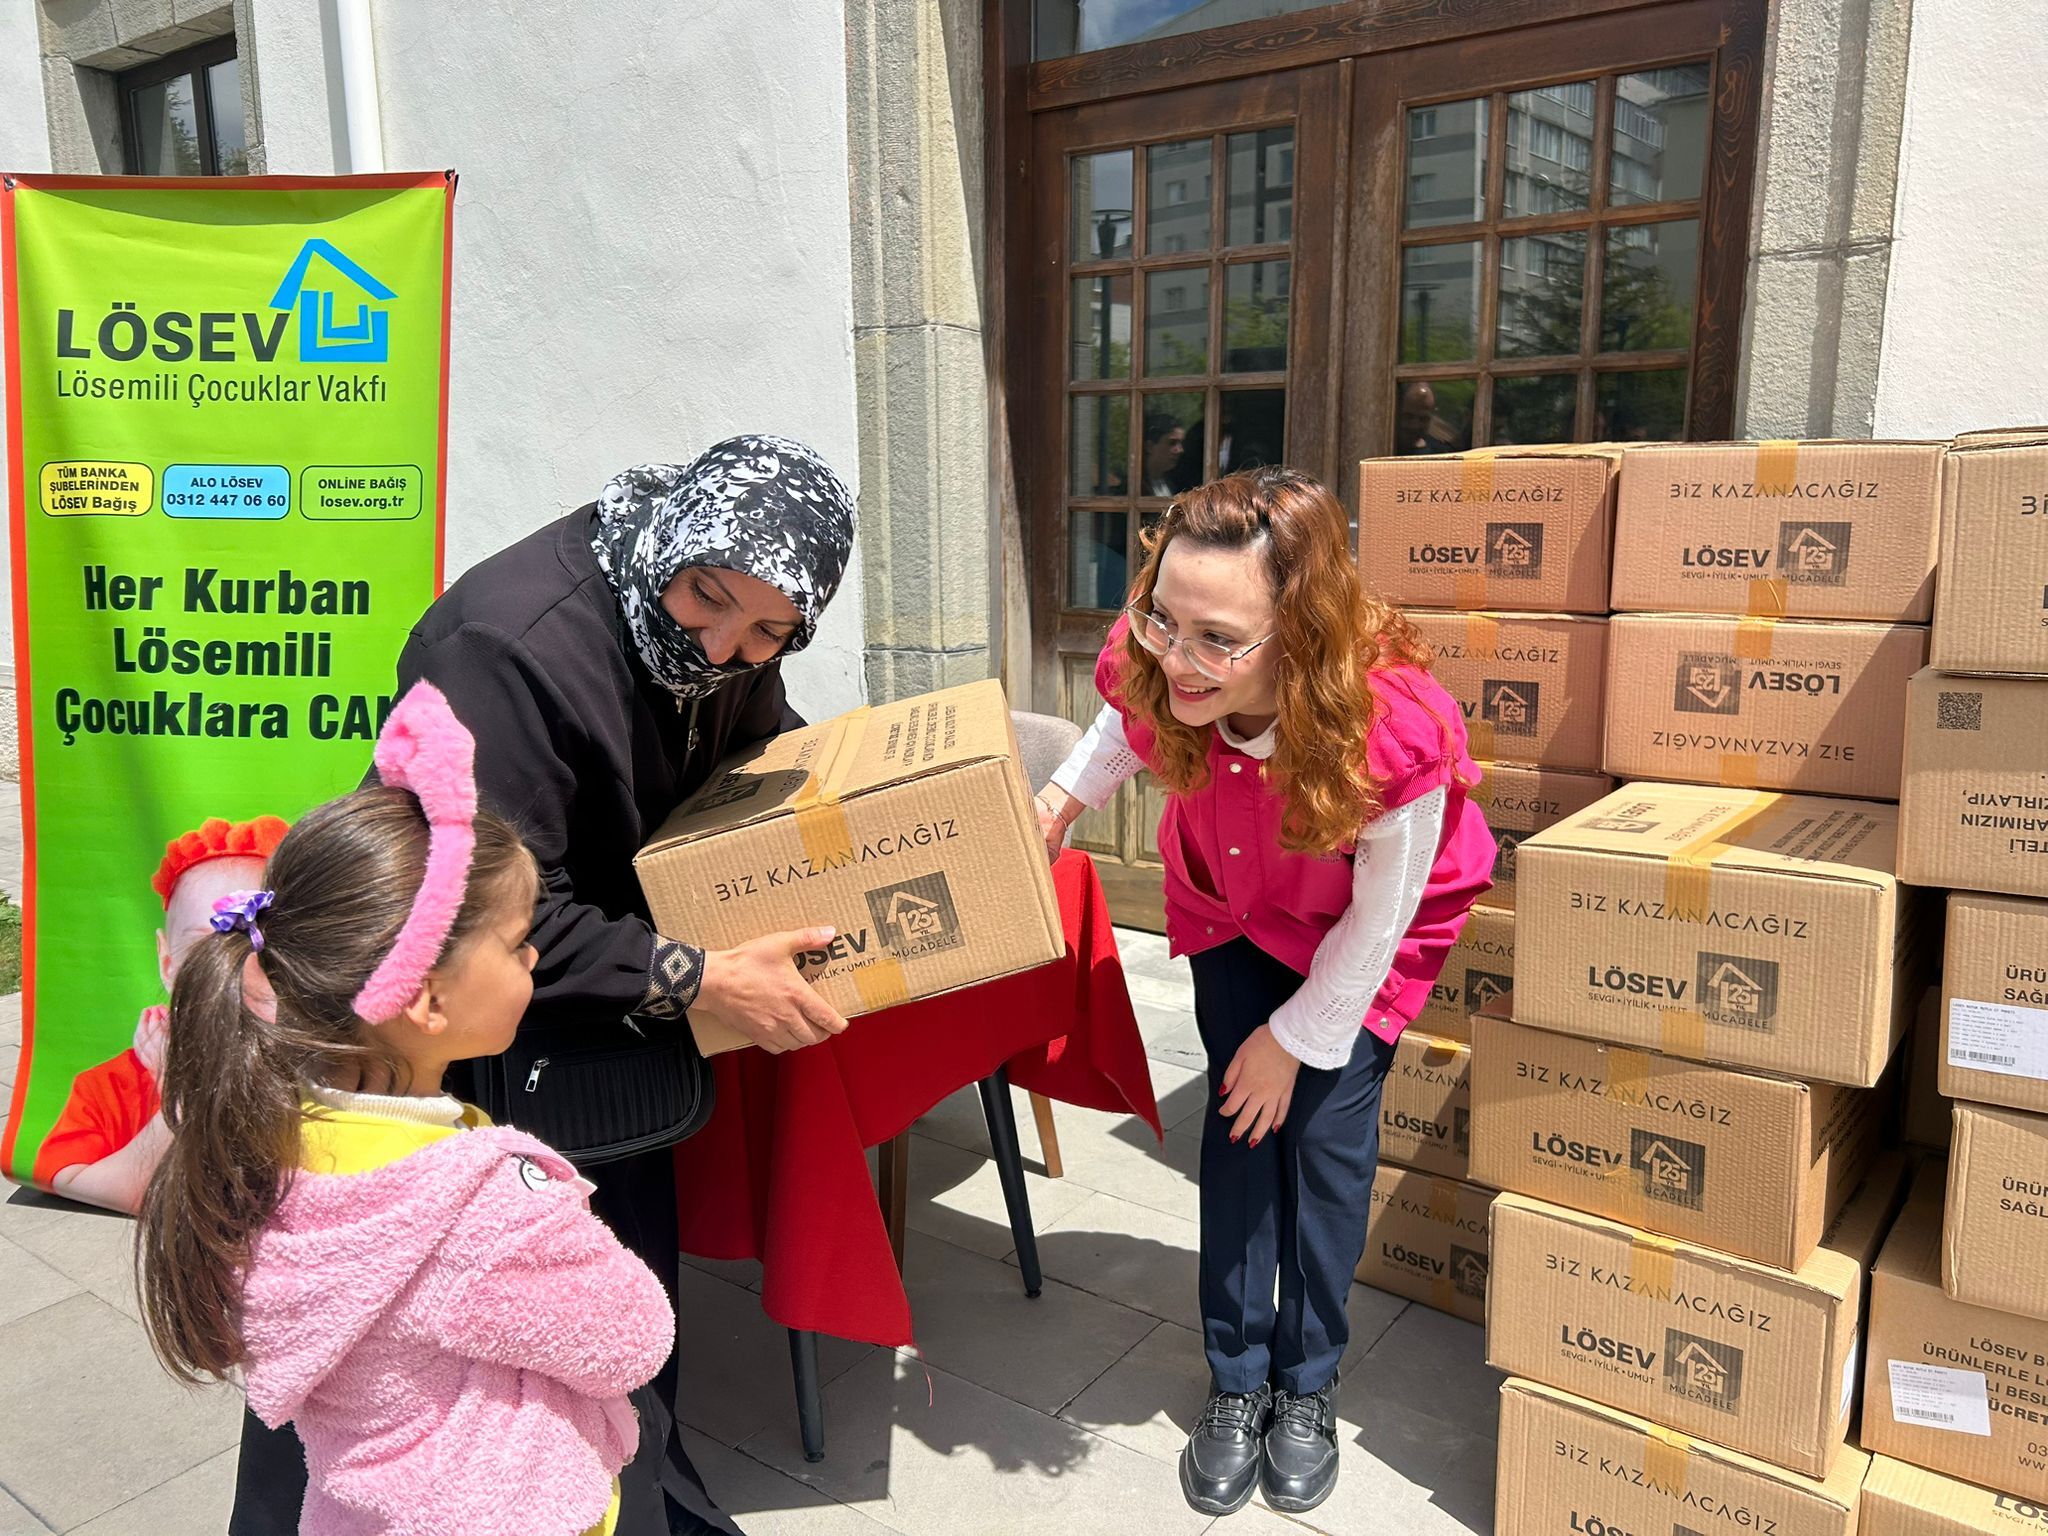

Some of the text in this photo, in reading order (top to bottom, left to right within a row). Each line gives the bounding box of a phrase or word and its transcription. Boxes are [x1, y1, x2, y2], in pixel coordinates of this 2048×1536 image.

[57, 302, 290, 362] LÖSEV
[57, 370, 387, 408] Lösemili Çocuklar Vakfı
[57, 466, 128, 479] TÜM BANKA
[190, 475, 263, 489] ALO LÖSEV
[318, 477, 407, 491] ONLİNE BAĞIŞ
[49, 476, 140, 493] ŞUBELERİNDEN
[1712, 480, 1879, 498] KAZANACAĞIZ
[52, 495, 137, 512] LÖSEV Bağış
[166, 493, 287, 508] 0312 447 06 60
[320, 495, 405, 510] losev.org.tr
[2021, 494, 2048, 515] Bİ
[1409, 544, 1480, 563] LÖSEV
[1682, 545, 1770, 568] LÖSEV
[1681, 571, 1706, 580] SEVGİ
[1712, 572, 1737, 581] İYİLİK
[1781, 573, 1841, 583] MÜCADELE
[83, 565, 370, 615] Her Kurban
[113, 626, 331, 677] Lösemili
[1431, 646, 1559, 663] AZANACAĞIZ
[1817, 660, 1842, 670] SEVGİ
[1748, 671, 1841, 697] LÖSEV
[55, 687, 289, 746] Çocuklara
[1652, 731, 1808, 757] KAZANACAĞIZ
[1961, 813, 2048, 831] ARIMIZIN
[767, 819, 960, 888] KAZANACAĞIZ
[2010, 839, 2048, 853] TELİ
[1618, 899, 1809, 939] KAZANACAĞIZ
[793, 929, 867, 971] SEV
[892, 935, 958, 960] MÜCADELE
[847, 957, 877, 972] UMUT
[2006, 964, 2047, 983] ÜRÜ
[1589, 965, 1688, 1000] LÖSEV
[1588, 992, 1615, 1004] SEVGİ
[1622, 996, 1650, 1011] İYİLİK
[2004, 988, 2048, 1004] SAĞ
[1702, 1010, 1769, 1030] MÜCADELE
[1403, 1064, 1470, 1092] KAZANA
[1560, 1071, 1731, 1126] KAZANACAĞIZ
[1384, 1110, 1448, 1139] LÖSEV
[1533, 1132, 1623, 1167] LÖSEV
[1533, 1155, 1557, 1169] SEVGİ
[1564, 1163, 1588, 1177] İYİLİK
[1401, 1199, 1488, 1235] KAZANACA
[2000, 1198, 2048, 1218] SAĞL
[1383, 1242, 1445, 1275] LÖSEV
[1591, 1267, 1771, 1332] KAZANACAĞIZ
[1561, 1325, 1656, 1370] LÖSEV
[1970, 1337, 2028, 1361] LÖSEV
[1561, 1349, 1655, 1385] SEVGİ İYİLİK UMUT
[1923, 1341, 2029, 1382] ÜRÜNLERLE
[1669, 1383, 1734, 1410] MÜCADELE
[2006, 1386, 2048, 1407] BESL
[1988, 1397, 2048, 1426] ÜCRET
[2027, 1442, 2048, 1457] 03
[1600, 1457, 1778, 1536] KAZANACAĞIZ
